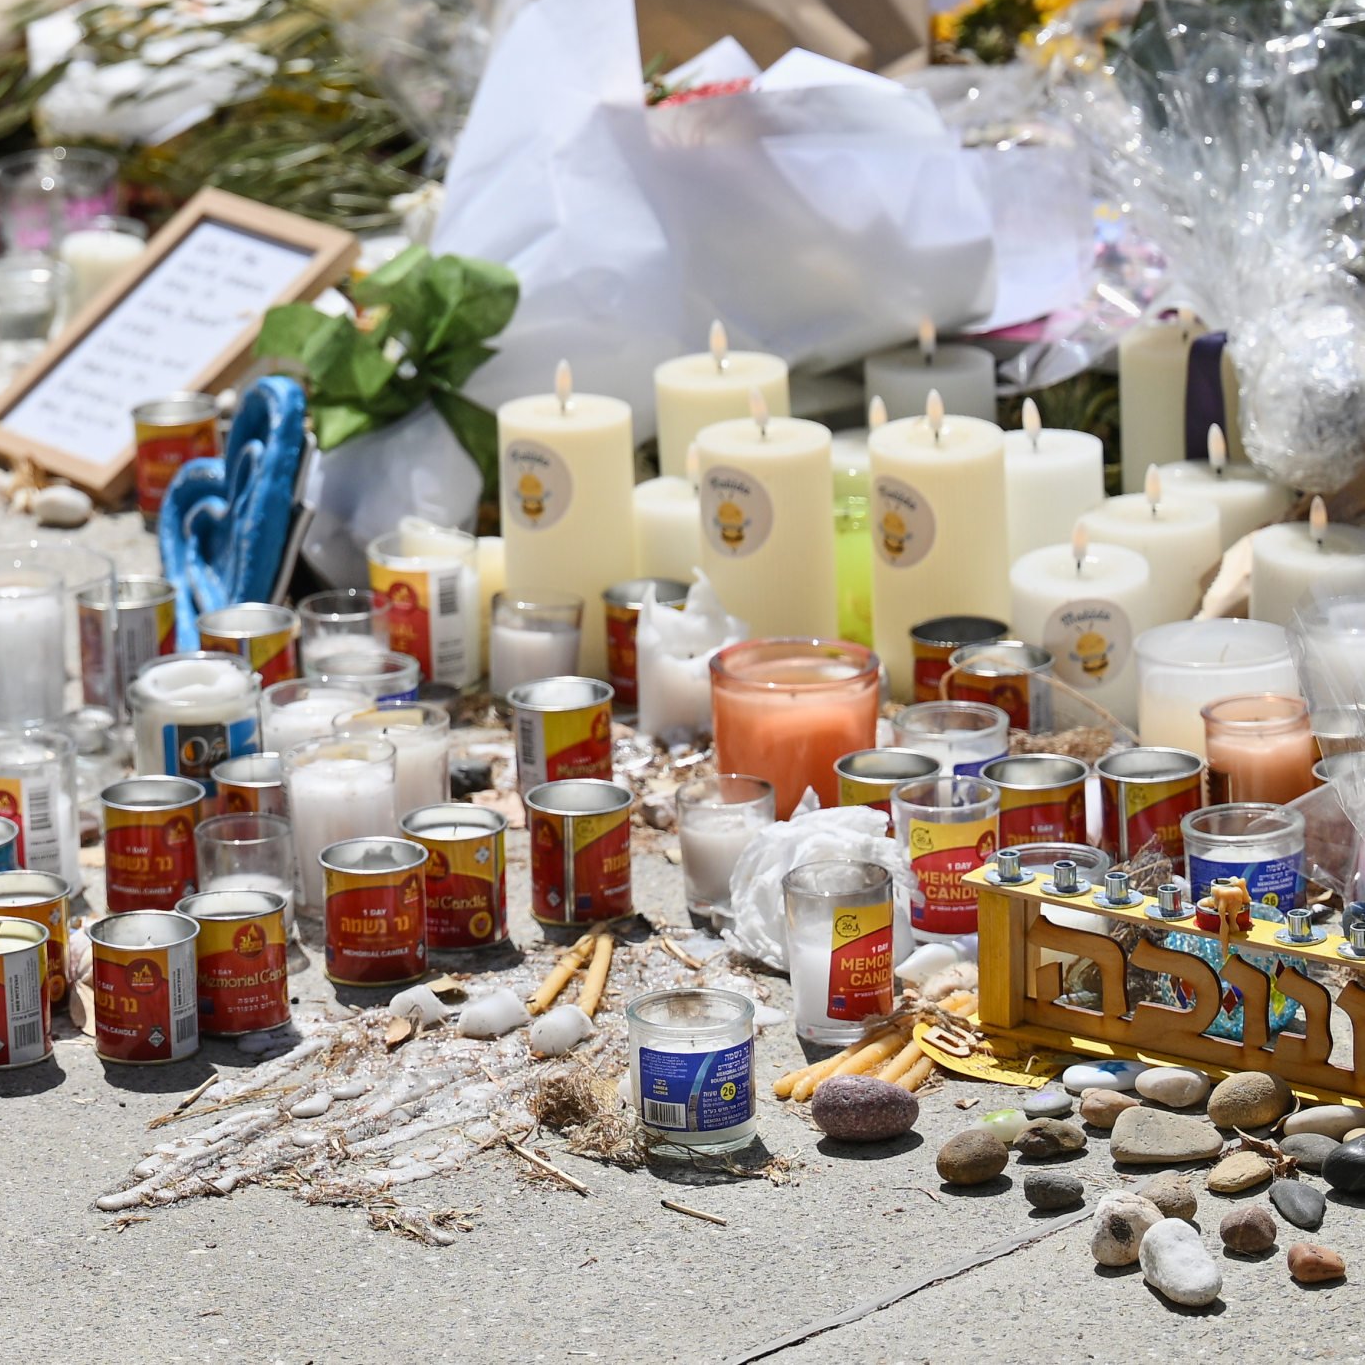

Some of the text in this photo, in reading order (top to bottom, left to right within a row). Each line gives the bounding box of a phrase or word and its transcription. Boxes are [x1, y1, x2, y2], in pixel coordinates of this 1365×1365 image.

[954, 861, 972, 871] DAY
[877, 942, 889, 953] DAY
[723, 1086, 734, 1097] 26
